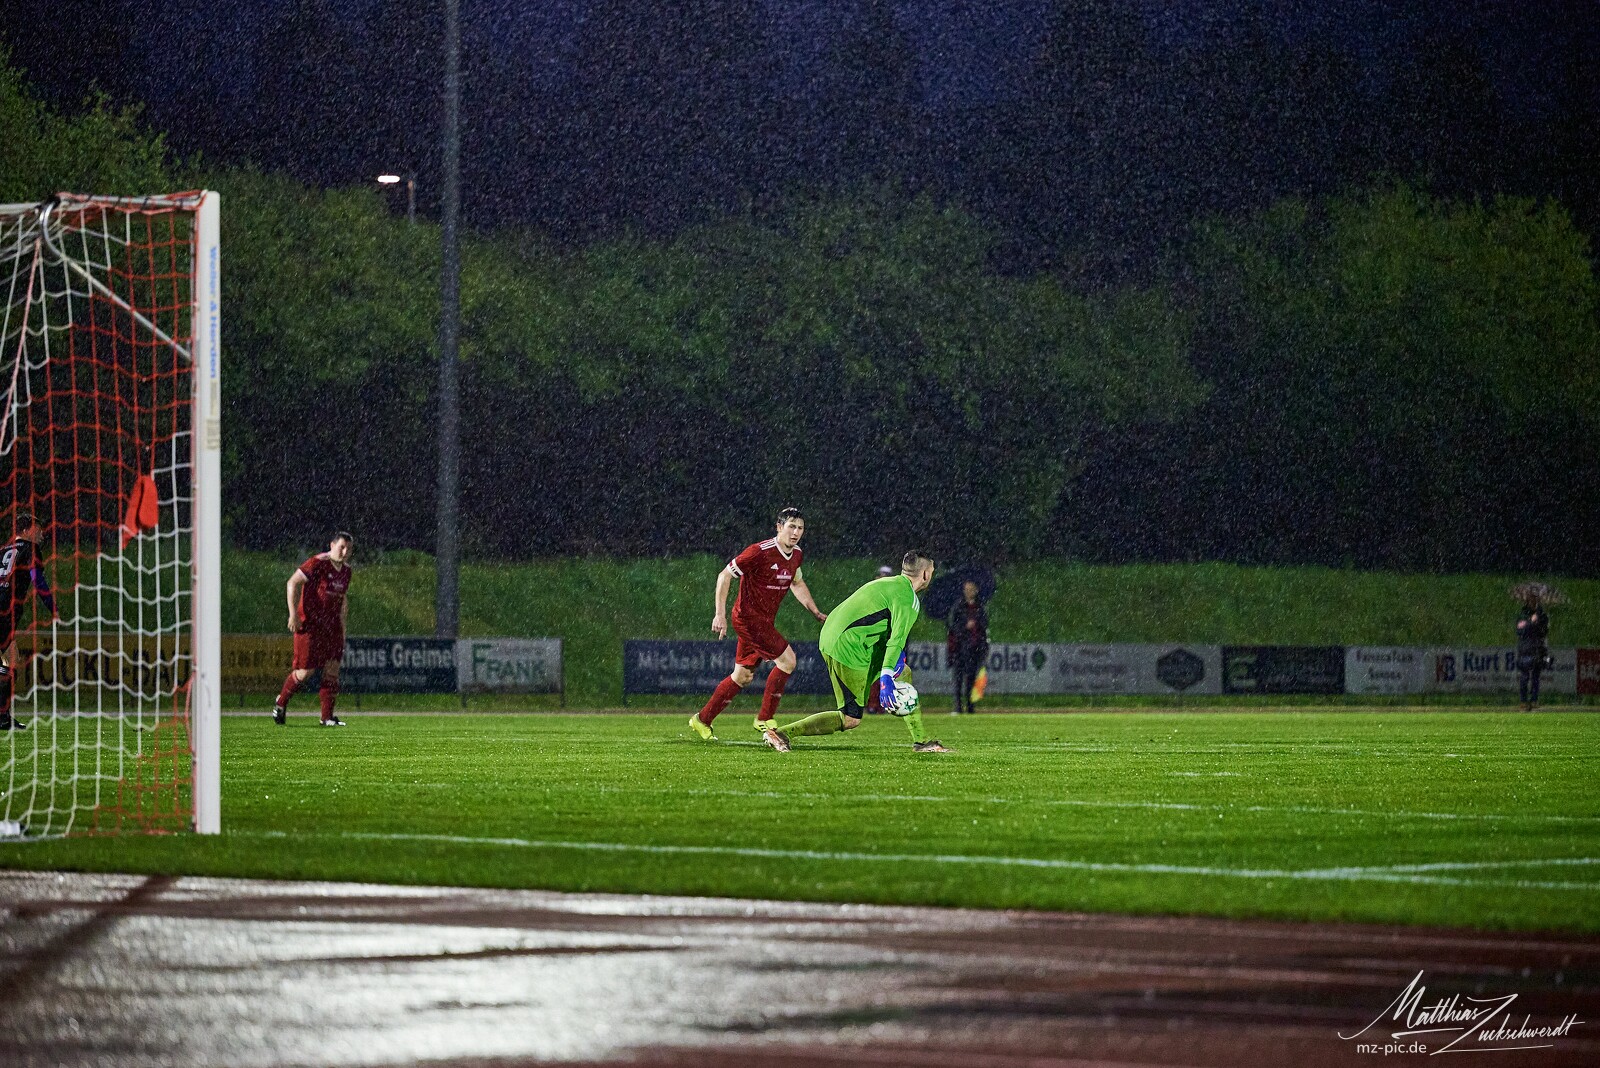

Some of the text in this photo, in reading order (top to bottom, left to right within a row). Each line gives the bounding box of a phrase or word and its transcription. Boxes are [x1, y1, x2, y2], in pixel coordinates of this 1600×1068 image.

[17, 638, 190, 686] TÖCKL-BAU
[472, 643, 546, 681] FRANK
[909, 646, 939, 672] zöl
[1463, 651, 1500, 673] Kurt
